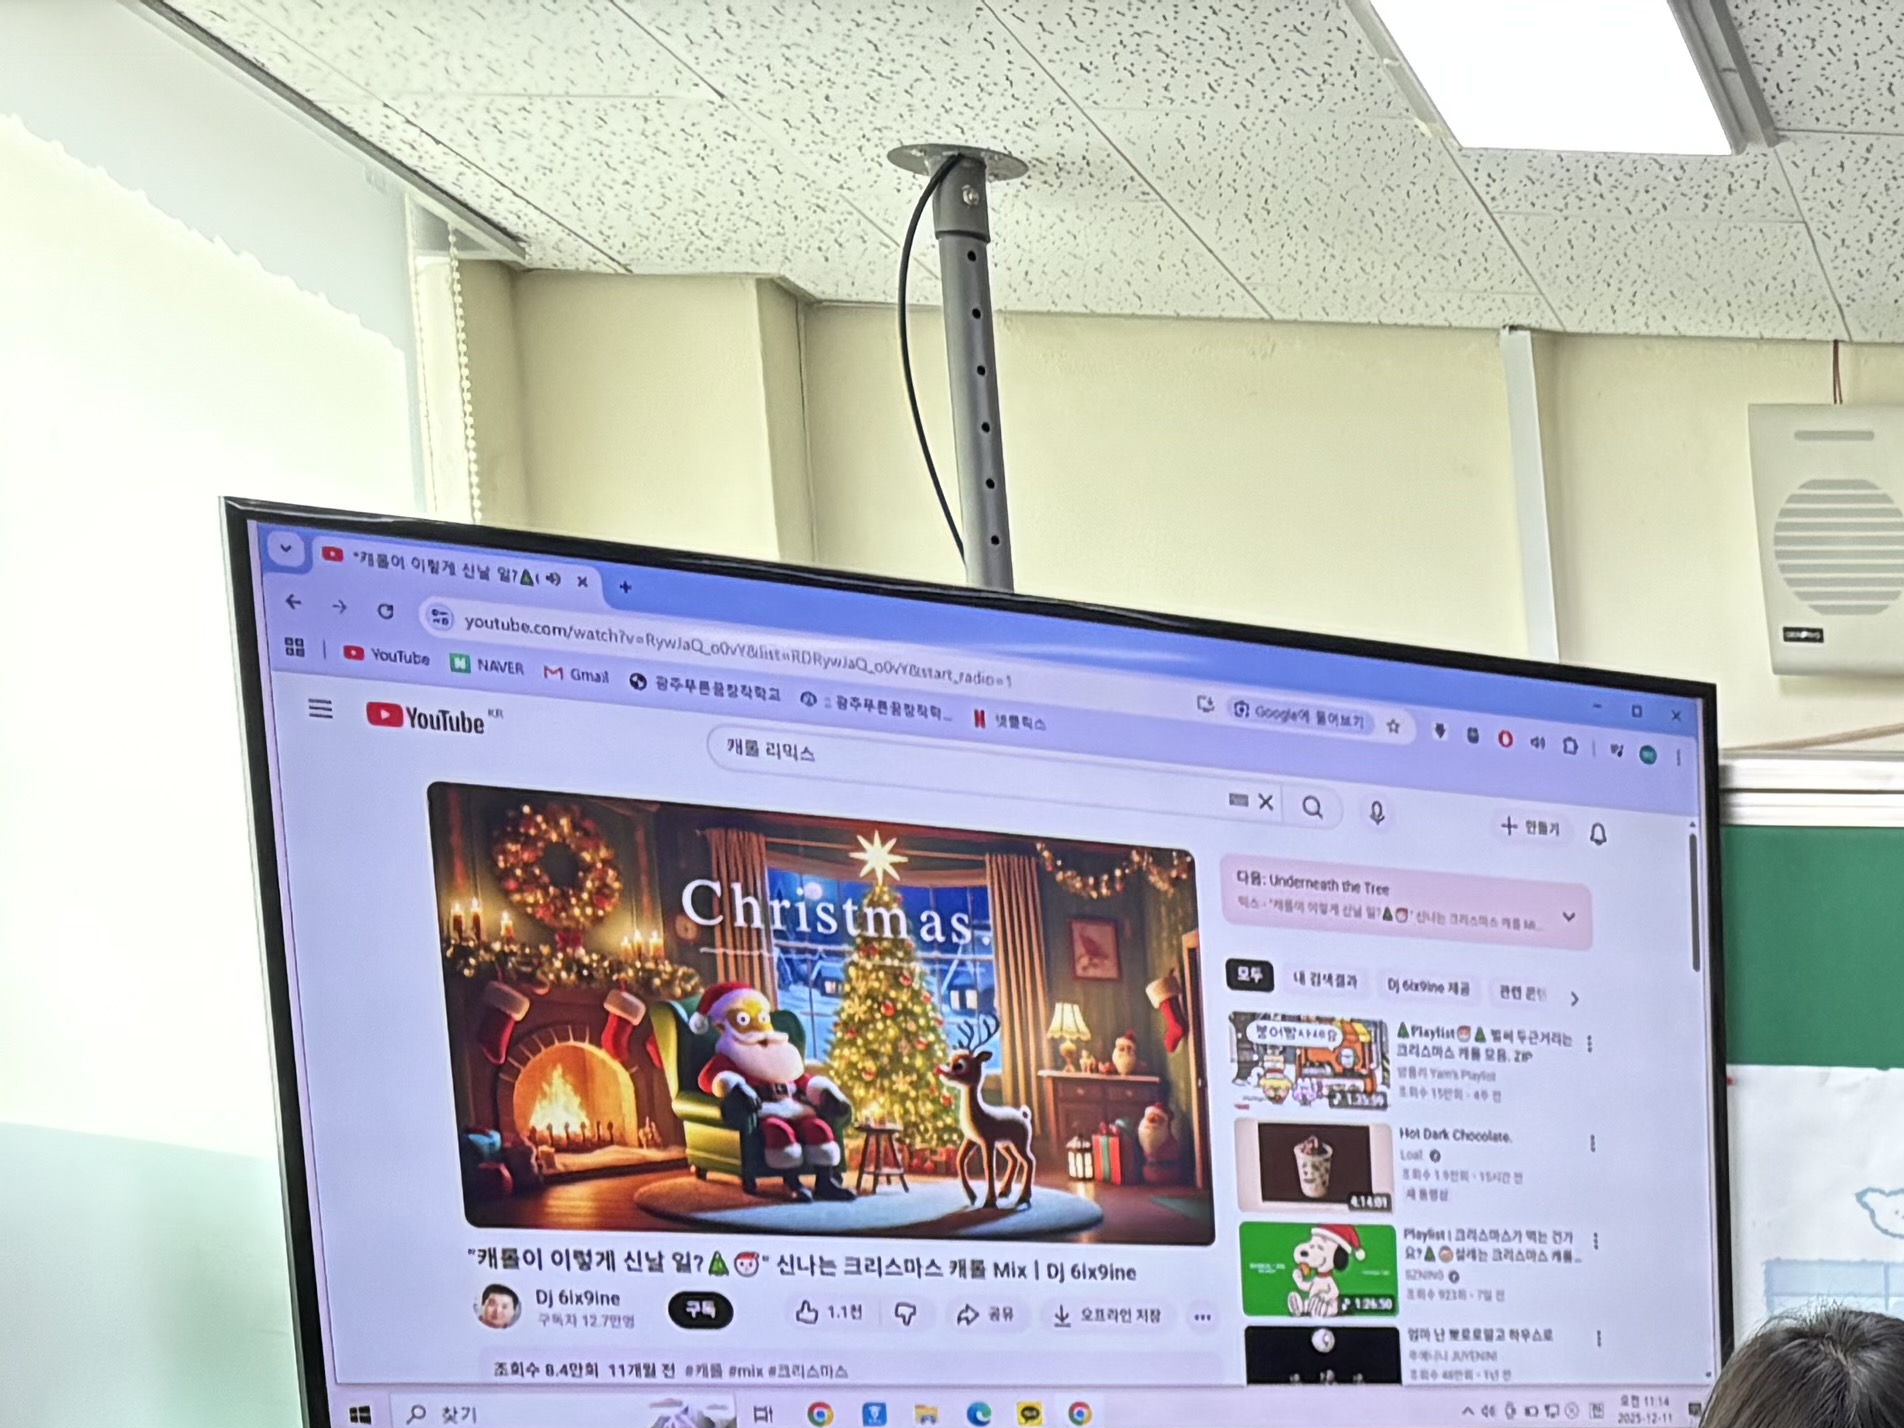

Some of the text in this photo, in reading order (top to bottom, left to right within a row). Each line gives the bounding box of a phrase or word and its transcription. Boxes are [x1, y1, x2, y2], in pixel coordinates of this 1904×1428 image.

[411, 555, 456, 577] 이렇게
[463, 561, 491, 582] 신날
[371, 648, 431, 667] YouTube
[477, 658, 524, 676] NAVER
[570, 668, 609, 685] Gmail
[405, 706, 504, 736] YouTube KR
[727, 738, 816, 763] 캐롤 리믹스
[1525, 819, 1560, 837] 만들기
[1269, 873, 1339, 894] Underneath
[1342, 879, 1361, 895] the
[1364, 882, 1390, 897] Tree
[1236, 966, 1263, 984] 모두
[1294, 970, 1358, 990] 내 검색결과
[1411, 1025, 1455, 1042] Playlist
[1400, 1127, 1513, 1145] Hot Dark Chocolate.
[551, 1249, 616, 1273] 이렇게
[624, 1251, 665, 1273] 신날
[672, 1252, 704, 1274] 일?
[776, 1254, 837, 1278] 신나는
[843, 1255, 944, 1280] 크리스마스
[949, 1258, 987, 1280] 캐롤
[993, 1262, 1028, 1280] Mix
[1046, 1262, 1066, 1283] Dj
[535, 1289, 552, 1307] Dj
[686, 1301, 716, 1318] 구독
[827, 1303, 863, 1321] 1.1천
[988, 1304, 1014, 1322] 공유
[1081, 1307, 1161, 1325] 오프라인 저장
[494, 1362, 540, 1378] 조회수
[545, 1362, 599, 1379] 8.4만회
[608, 1362, 656, 1379] 11개월
[662, 1362, 675, 1379] 전
[728, 1364, 763, 1379] #mix
[768, 1363, 848, 1380] #크리스마스
[441, 1406, 477, 1425] 찾기
